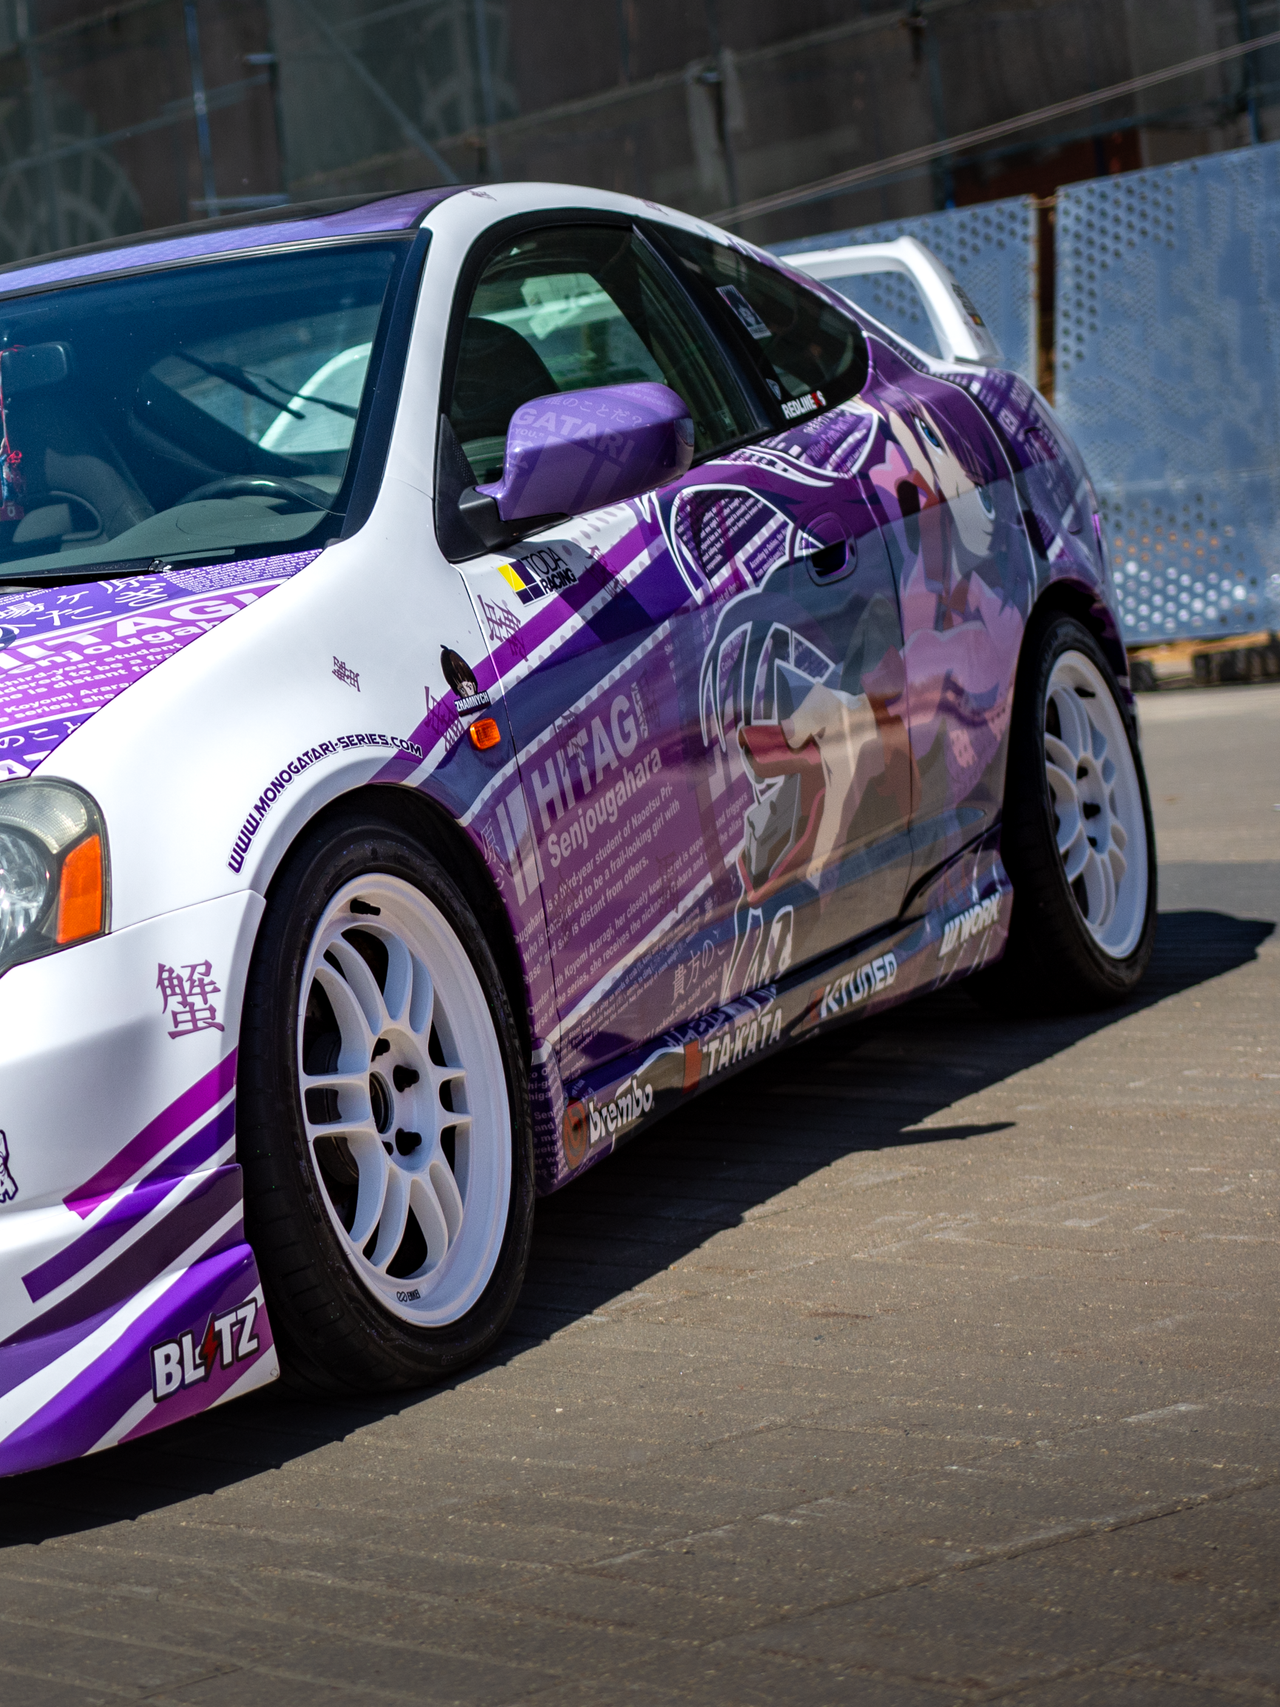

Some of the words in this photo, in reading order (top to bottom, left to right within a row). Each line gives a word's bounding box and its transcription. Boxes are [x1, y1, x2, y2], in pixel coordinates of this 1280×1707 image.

[522, 547, 568, 575] TODA
[540, 567, 577, 593] RACING
[53, 669, 129, 689] distant
[68, 669, 92, 677] to
[103, 642, 183, 662] student
[4, 692, 75, 713] Koyomi
[547, 746, 662, 868] Senjougahara
[595, 830, 622, 864] student
[623, 820, 630, 837] of
[631, 796, 660, 829] Naoetsu
[660, 779, 672, 801] Pri-
[522, 942, 537, 964] who
[584, 885, 592, 899] to
[593, 875, 603, 890] be
[604, 869, 610, 880] a
[610, 828, 652, 874] frail-looking
[652, 812, 664, 837] girl
[664, 799, 680, 821] with
[572, 922, 579, 936] is
[580, 894, 605, 928] distant
[606, 879, 623, 902] from
[624, 857, 649, 884] others.
[564, 947, 588, 979] Koyomi
[589, 923, 614, 956] Araragi,
[615, 913, 625, 929] her
[627, 891, 648, 918] closely
[567, 972, 589, 997] series,
[590, 958, 601, 975] she
[603, 930, 629, 962] receives
[630, 919, 641, 934] the
[693, 853, 704, 872] and
[156, 960, 225, 1039] 蟹
[589, 1074, 654, 1145] brembo
[153, 1302, 259, 1398] BLITZ
